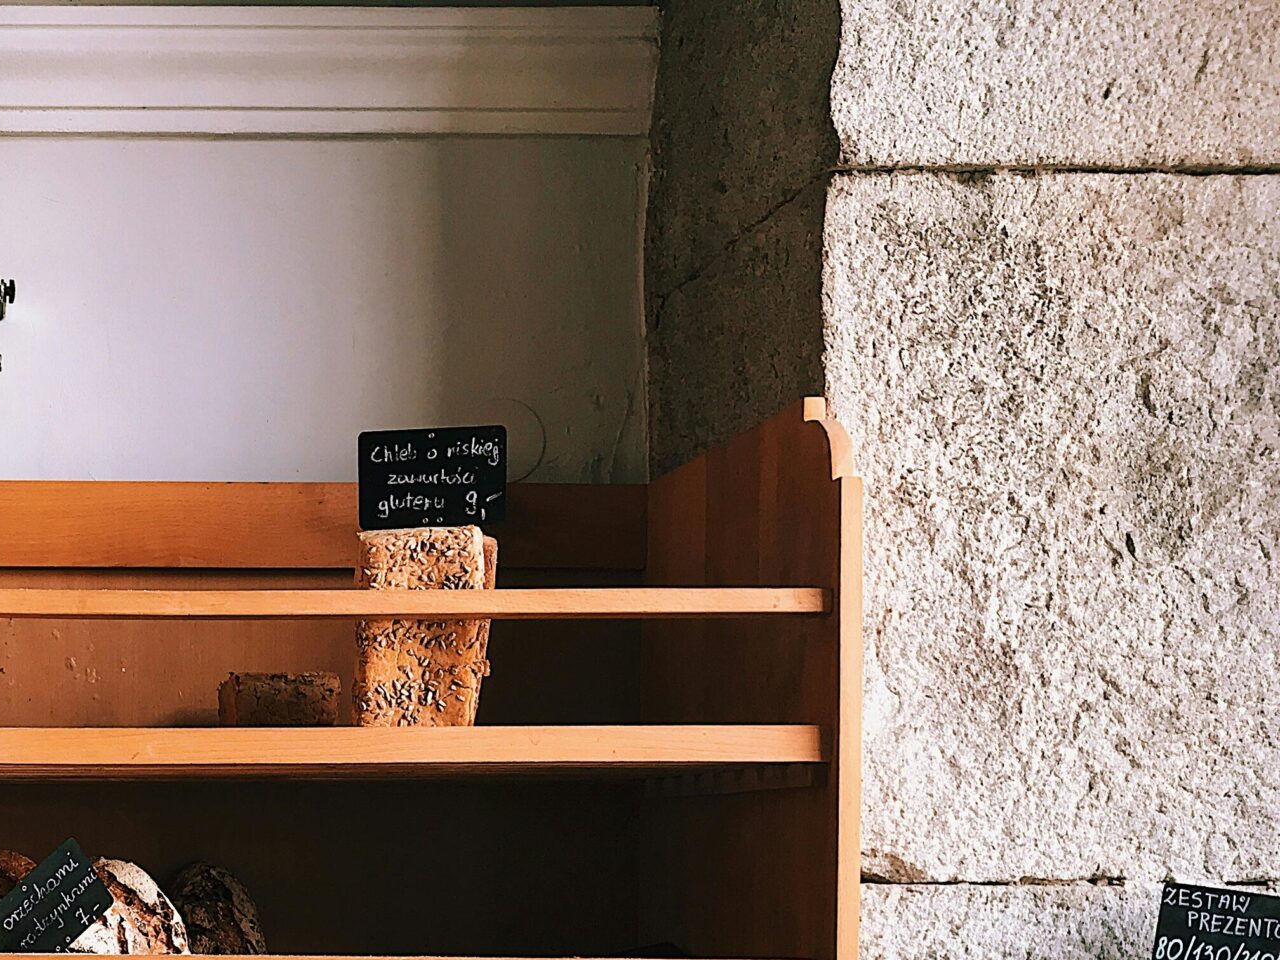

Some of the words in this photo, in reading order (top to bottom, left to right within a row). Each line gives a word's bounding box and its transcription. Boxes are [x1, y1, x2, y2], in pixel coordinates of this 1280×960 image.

[427, 449, 438, 460] o
[3, 852, 79, 931] orzechami
[1164, 887, 1250, 913] ZESTAW
